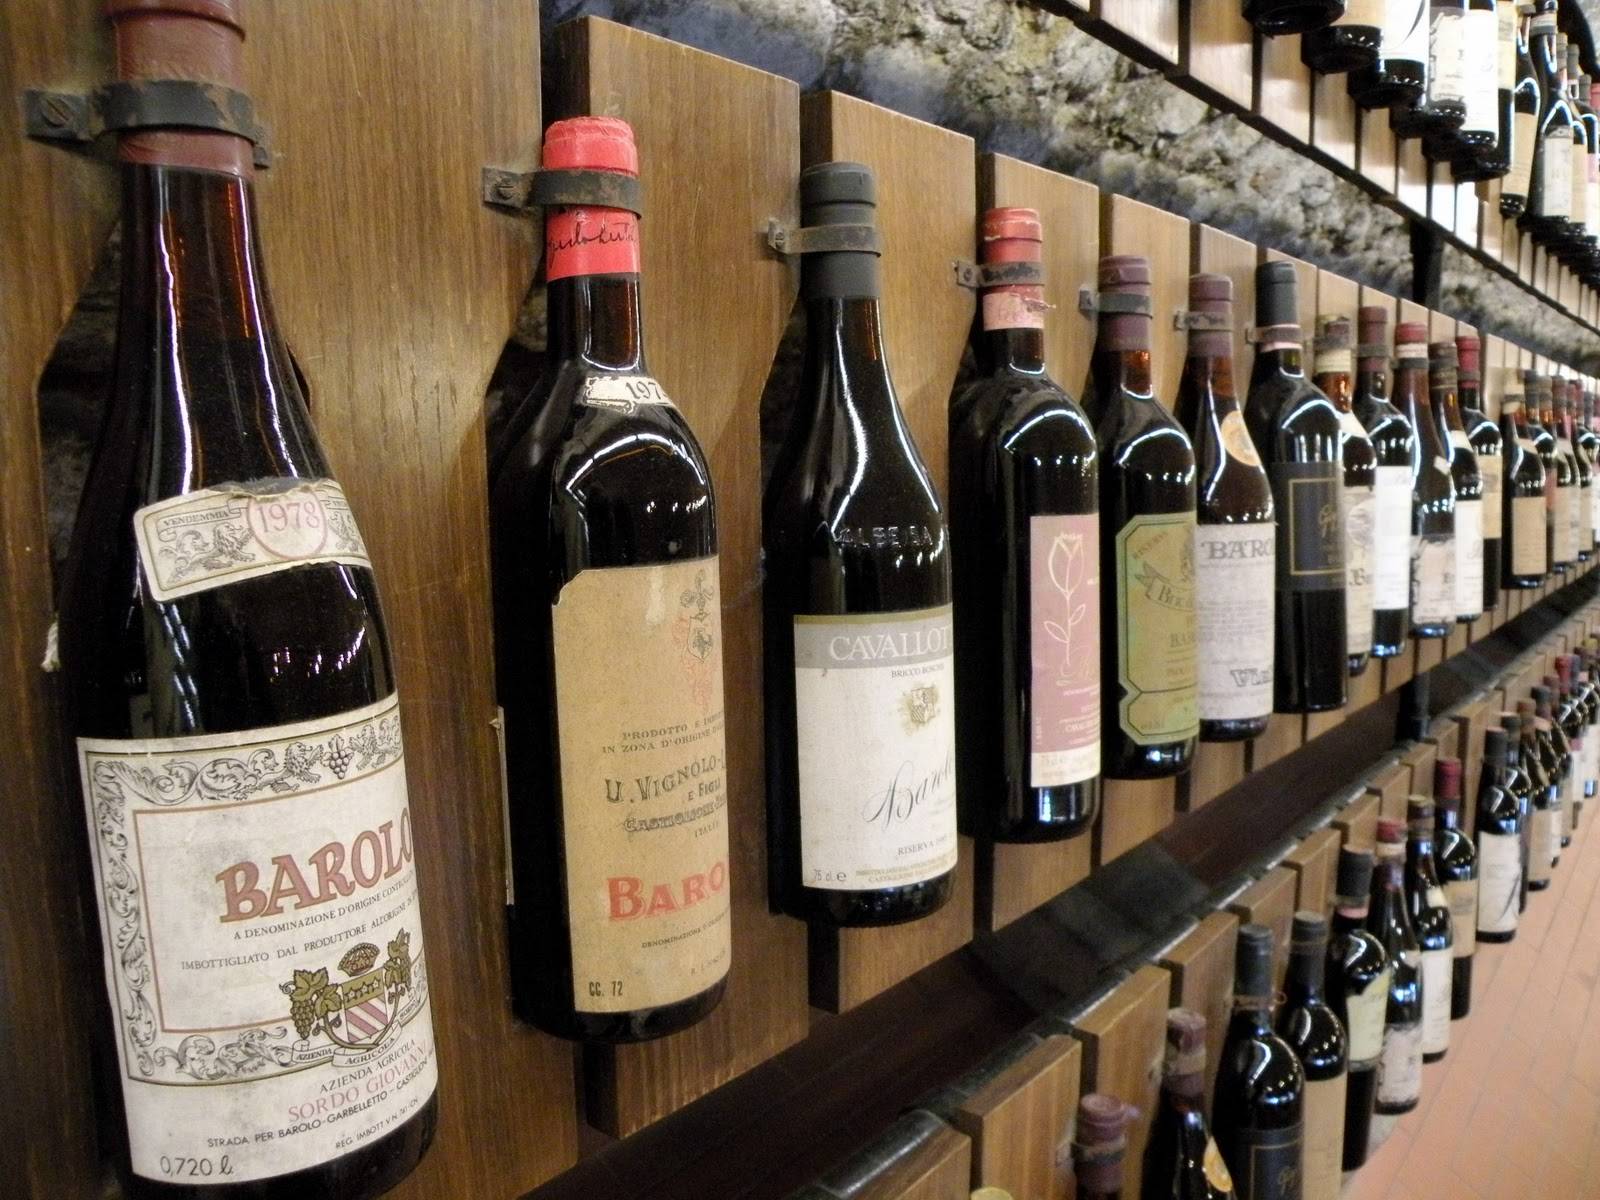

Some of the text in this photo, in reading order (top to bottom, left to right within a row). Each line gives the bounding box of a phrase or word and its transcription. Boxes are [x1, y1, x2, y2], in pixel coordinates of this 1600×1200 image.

[625, 380, 667, 399] 197
[162, 510, 229, 528] VENDEMMIA
[257, 499, 321, 535] 1978
[622, 723, 688, 740] PRODOTTO
[602, 745, 616, 753] IN
[622, 743, 655, 753] ZONA
[897, 840, 934, 856] RISERVA
[215, 807, 413, 923] BAROLO
[607, 861, 728, 923] BARO
[233, 931, 243, 941] A
[245, 909, 336, 939] DENOMINAZIONE
[338, 892, 382, 917] D'ORIGINE
[181, 952, 269, 970] IMBOTTIGLIATO
[277, 946, 298, 958] DAL
[304, 923, 367, 952] PRODUTTORE
[296, 1048, 332, 1060] AZIENDA
[345, 1038, 395, 1064] AGRICOLA
[320, 1039, 416, 1094] AZIENDA AGRICOLA
[288, 1086, 360, 1122] SORDO
[207, 1136, 249, 1148] STRADA
[255, 1131, 274, 1142] PER
[160, 1156, 212, 1177] 0,720
